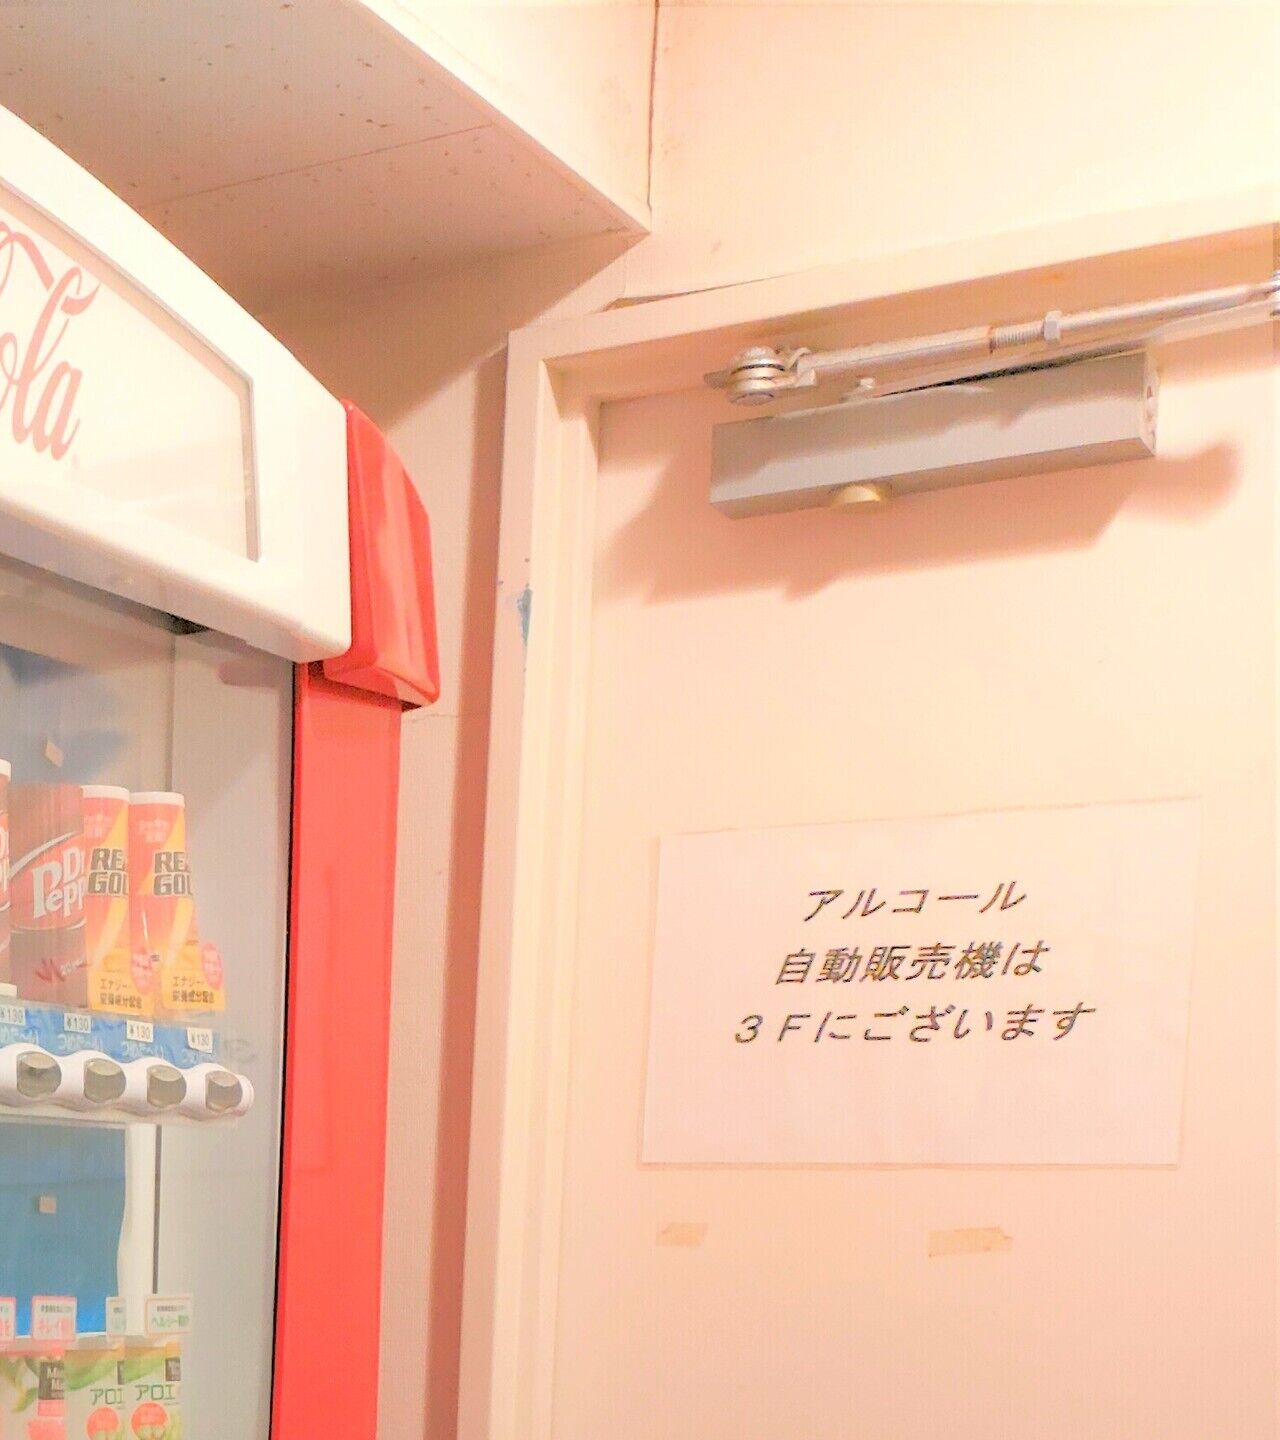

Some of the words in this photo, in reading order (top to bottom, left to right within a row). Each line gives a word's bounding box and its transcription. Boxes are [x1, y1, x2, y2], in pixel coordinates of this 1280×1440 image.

[90, 847, 129, 872] RE
[153, 850, 191, 875] RE
[802, 880, 1028, 923] アルコール
[775, 940, 1051, 985] 自動販売機は
[735, 1001, 1097, 1044] 3Fにございます
[135, 1384, 176, 1401] アロエ
